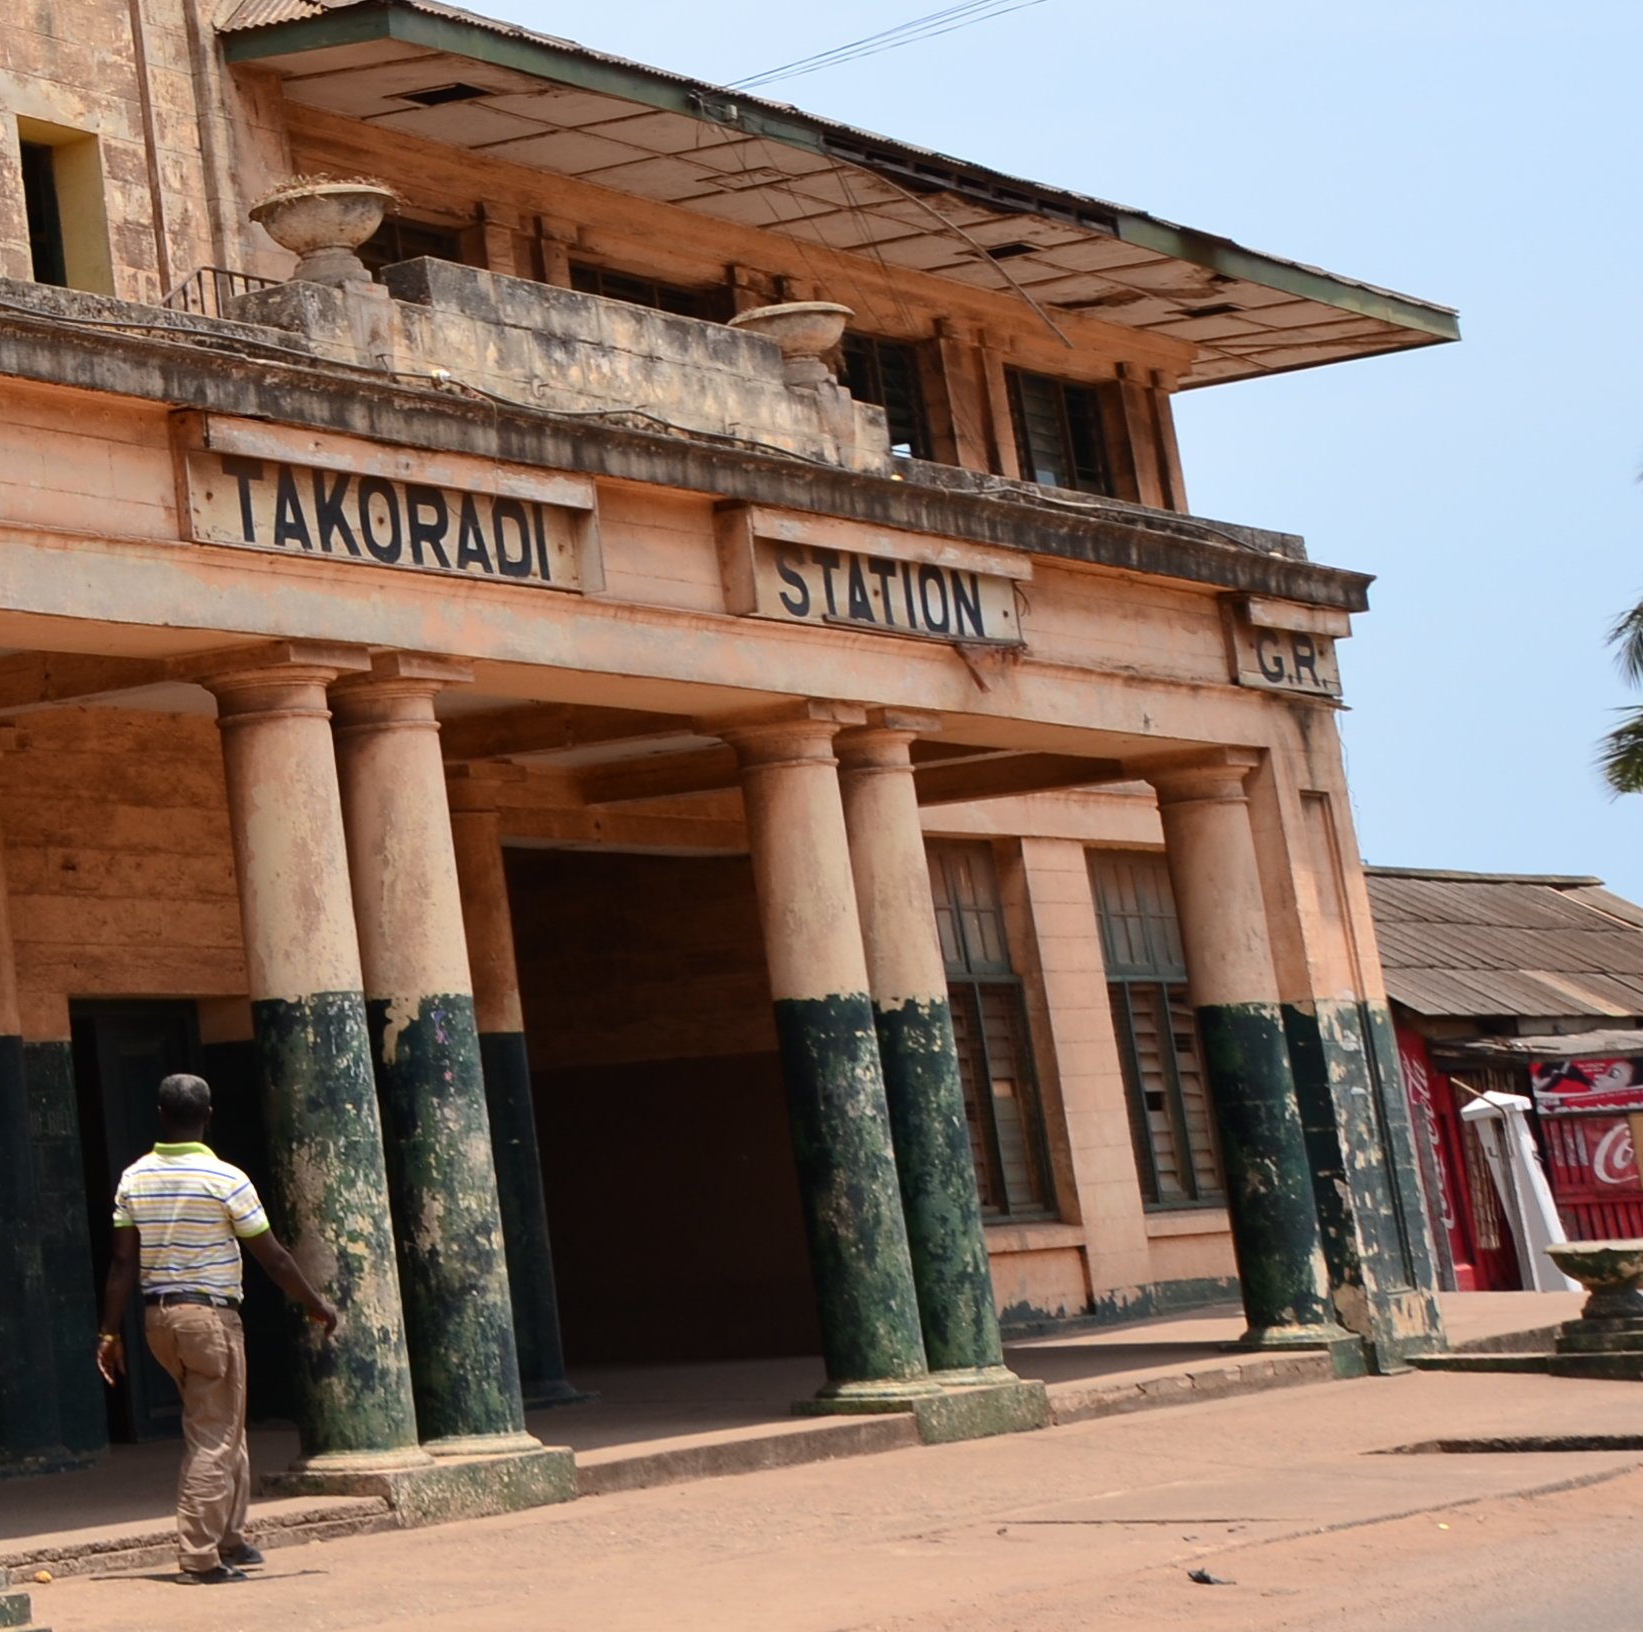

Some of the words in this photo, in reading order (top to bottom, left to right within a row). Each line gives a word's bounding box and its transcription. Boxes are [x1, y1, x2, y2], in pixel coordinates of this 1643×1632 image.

[221, 454, 551, 581] TAKORADI
[775, 545, 985, 637] STATION
[1257, 629, 1329, 688] G.R.
